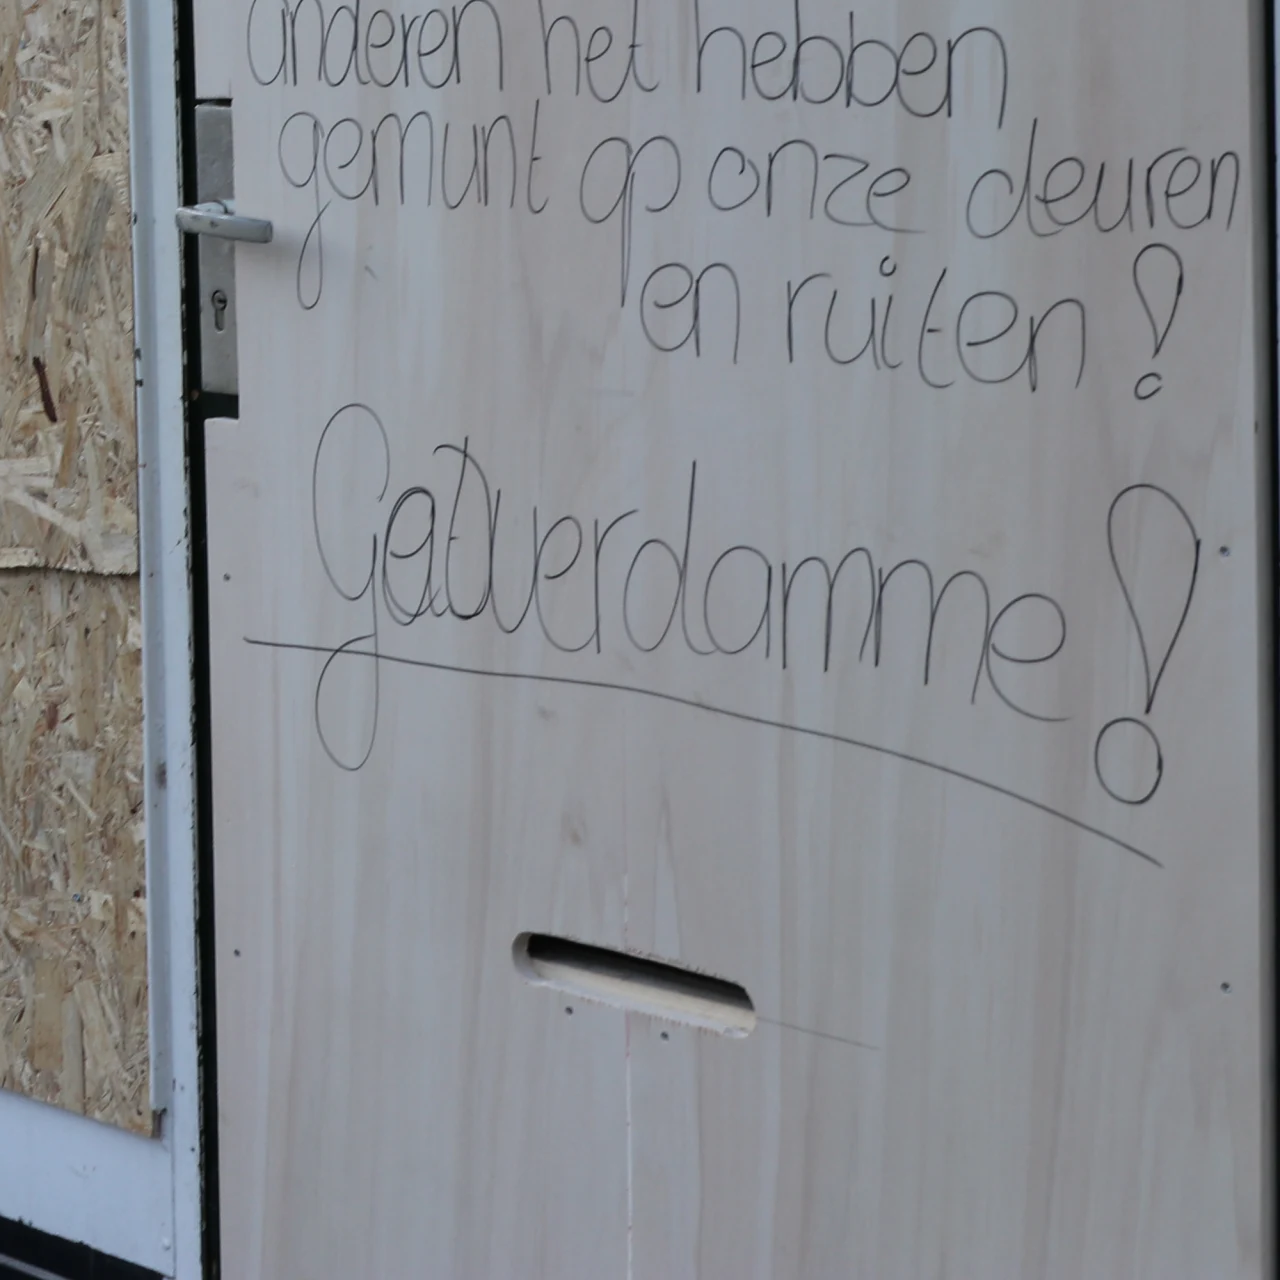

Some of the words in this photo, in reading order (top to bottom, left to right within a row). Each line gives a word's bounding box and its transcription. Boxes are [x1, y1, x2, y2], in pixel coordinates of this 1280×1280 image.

[277, 98, 549, 311] gemunt
[579, 134, 682, 308] op
[707, 136, 927, 236] onze
[964, 117, 1241, 241] deuren
[639, 260, 742, 365] en
